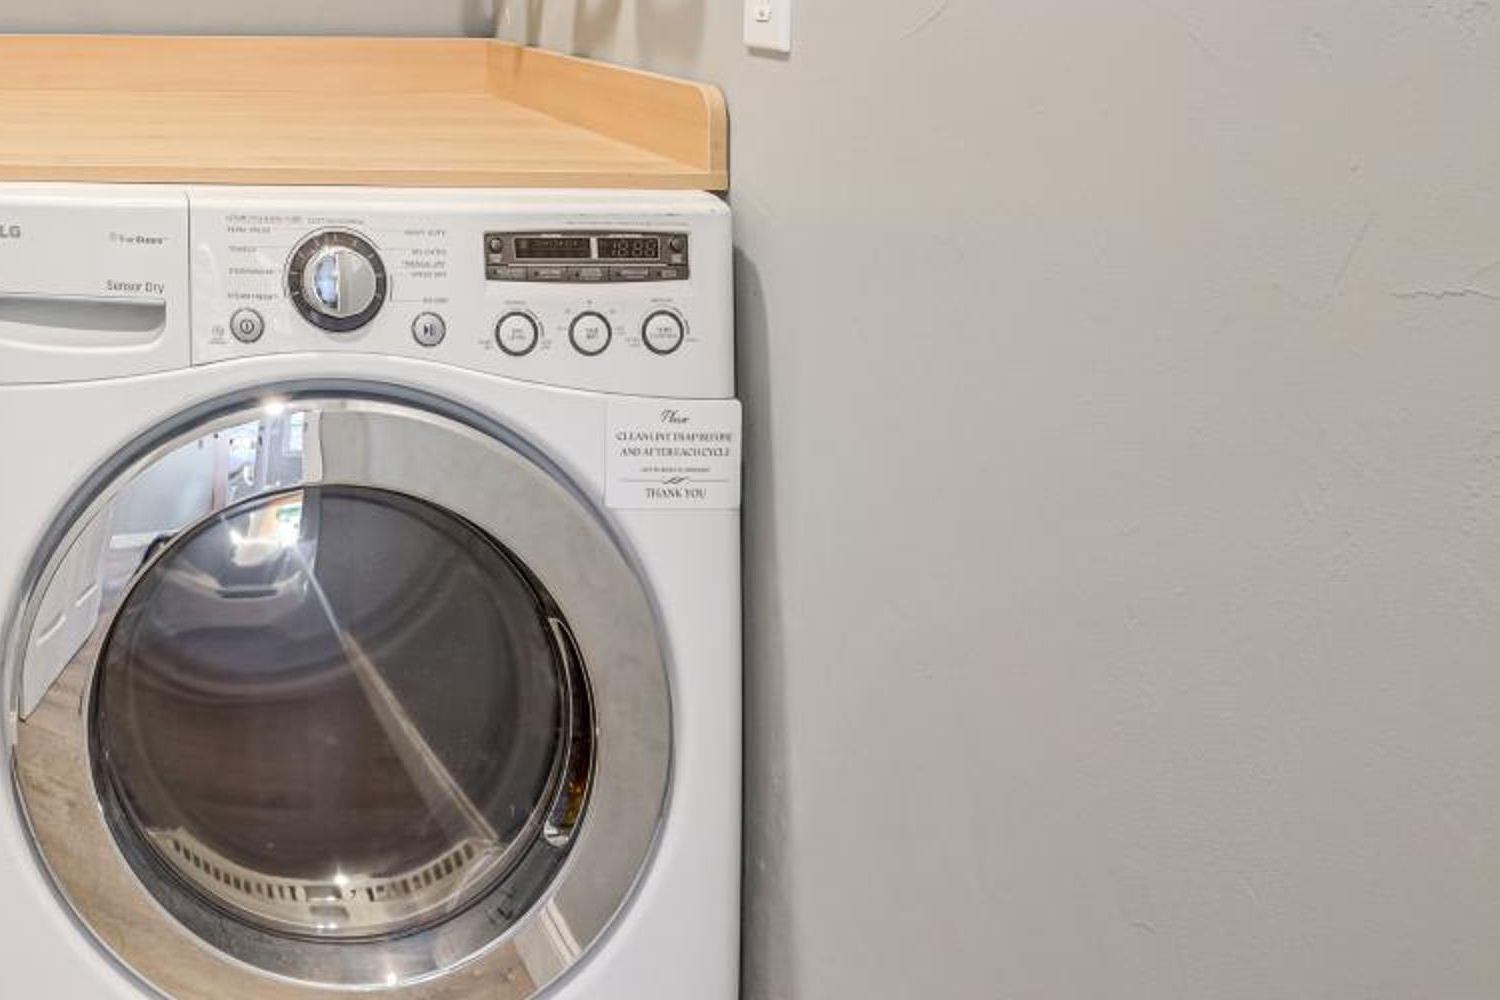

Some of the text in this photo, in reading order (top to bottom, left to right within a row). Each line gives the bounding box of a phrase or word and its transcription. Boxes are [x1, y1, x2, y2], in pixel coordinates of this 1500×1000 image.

[0, 224, 22, 239] LG
[145, 281, 165, 295] Dry
[645, 487, 707, 499] THANK YOU
